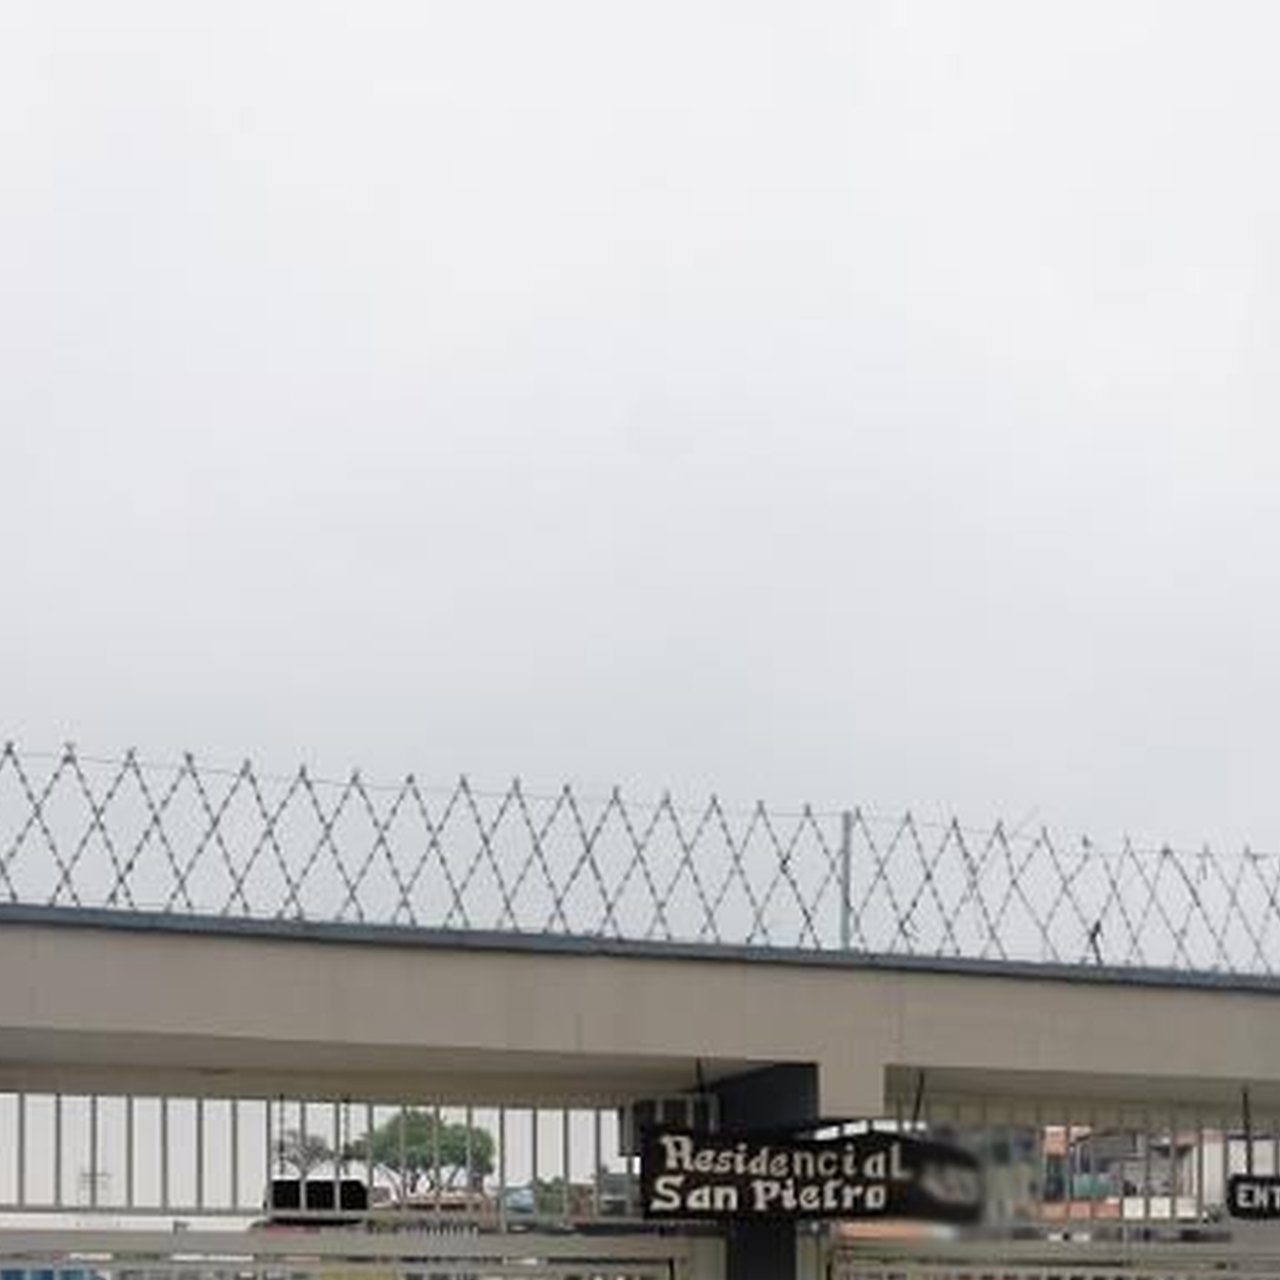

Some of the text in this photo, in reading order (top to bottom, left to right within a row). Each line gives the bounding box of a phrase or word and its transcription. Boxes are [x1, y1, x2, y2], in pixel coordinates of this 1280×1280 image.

[660, 1134, 910, 1179] Residencial
[650, 1176, 737, 1212] San
[752, 1179, 887, 1212] Pietro
